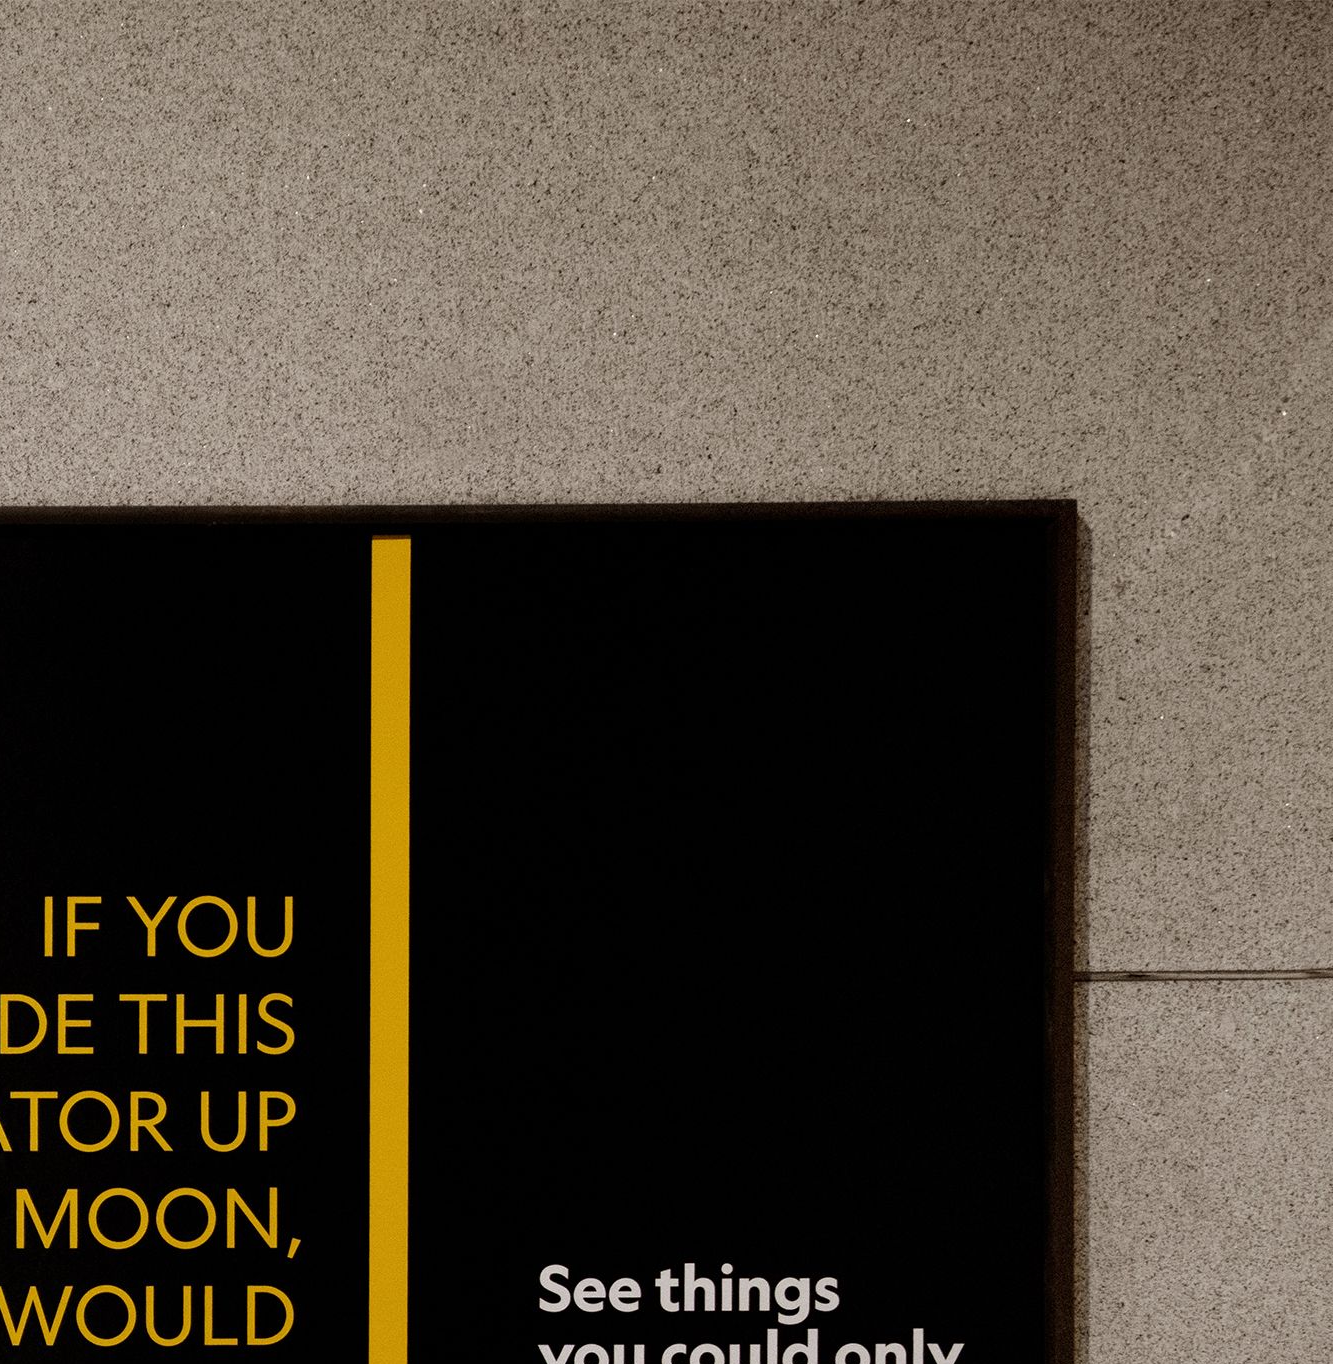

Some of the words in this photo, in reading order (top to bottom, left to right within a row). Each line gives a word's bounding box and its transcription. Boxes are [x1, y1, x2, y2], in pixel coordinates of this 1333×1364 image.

[44, 895, 102, 958] IF
[125, 895, 294, 958] YOU
[118, 992, 296, 1056] THIS
[200, 1090, 297, 1153] UP
[15, 1186, 302, 1259] MOON,
[538, 1264, 642, 1313] See
[654, 1262, 840, 1326] things
